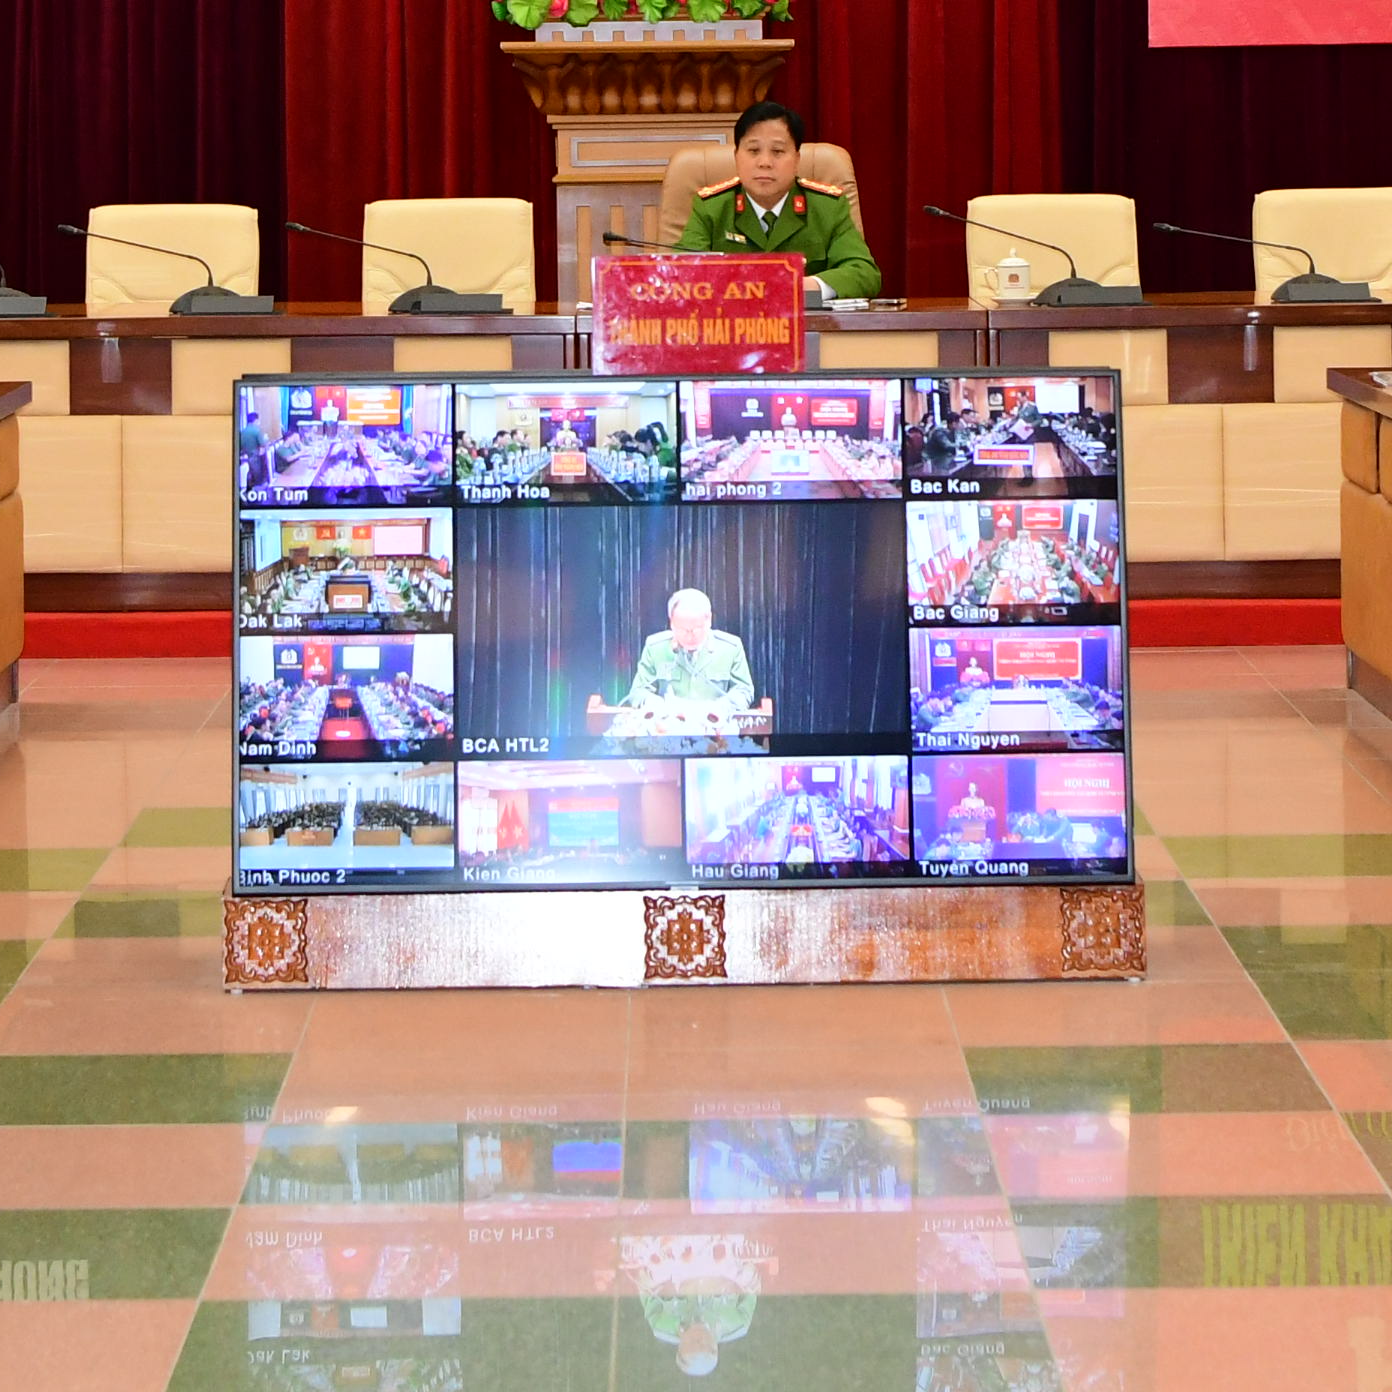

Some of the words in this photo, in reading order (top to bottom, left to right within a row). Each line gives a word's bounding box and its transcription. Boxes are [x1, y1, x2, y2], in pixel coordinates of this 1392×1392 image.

[724, 281, 766, 300] AN
[666, 309, 699, 345] PHỐ
[703, 307, 730, 345] HẢI
[734, 312, 790, 345] PHÒNG
[273, 487, 308, 501] Tum
[460, 484, 512, 499] Thanh
[517, 484, 550, 499] Hoa
[686, 482, 711, 496] hai
[716, 482, 766, 499] phong
[772, 481, 782, 495] 2
[910, 478, 943, 494] Bac
[947, 478, 980, 493] Kan
[273, 613, 303, 628] Lak
[913, 606, 945, 620] Bac
[950, 605, 999, 622] Giang
[278, 740, 317, 756] Dinh
[462, 738, 500, 753] BCA
[506, 738, 549, 752] HTL2
[917, 732, 952, 747] Thai
[958, 732, 1020, 749] Nguyen
[278, 869, 330, 884] Phuoc
[336, 869, 346, 884] 2
[463, 867, 501, 881] Kien
[692, 863, 724, 878] Hau
[730, 863, 779, 880] Giang
[974, 860, 1028, 877] Quang
